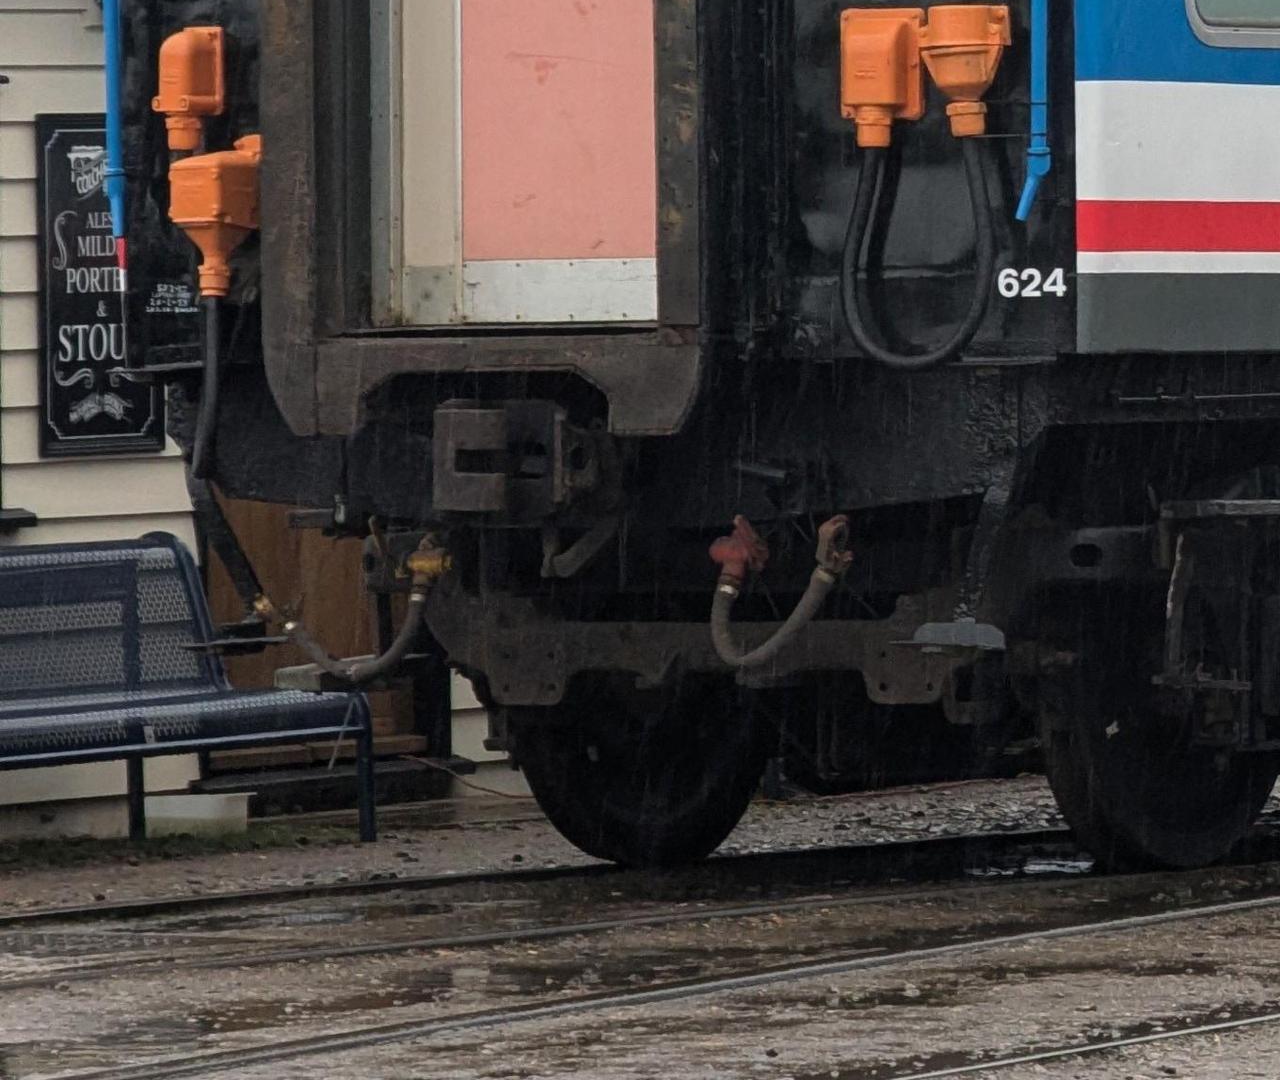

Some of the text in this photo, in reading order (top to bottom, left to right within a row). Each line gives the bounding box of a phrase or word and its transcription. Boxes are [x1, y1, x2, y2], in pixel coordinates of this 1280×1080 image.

[77, 235, 117, 257] MILD
[66, 267, 121, 293] PORTE
[997, 267, 1067, 298] 624
[96, 300, 108, 317] &
[58, 324, 126, 362] STOU
